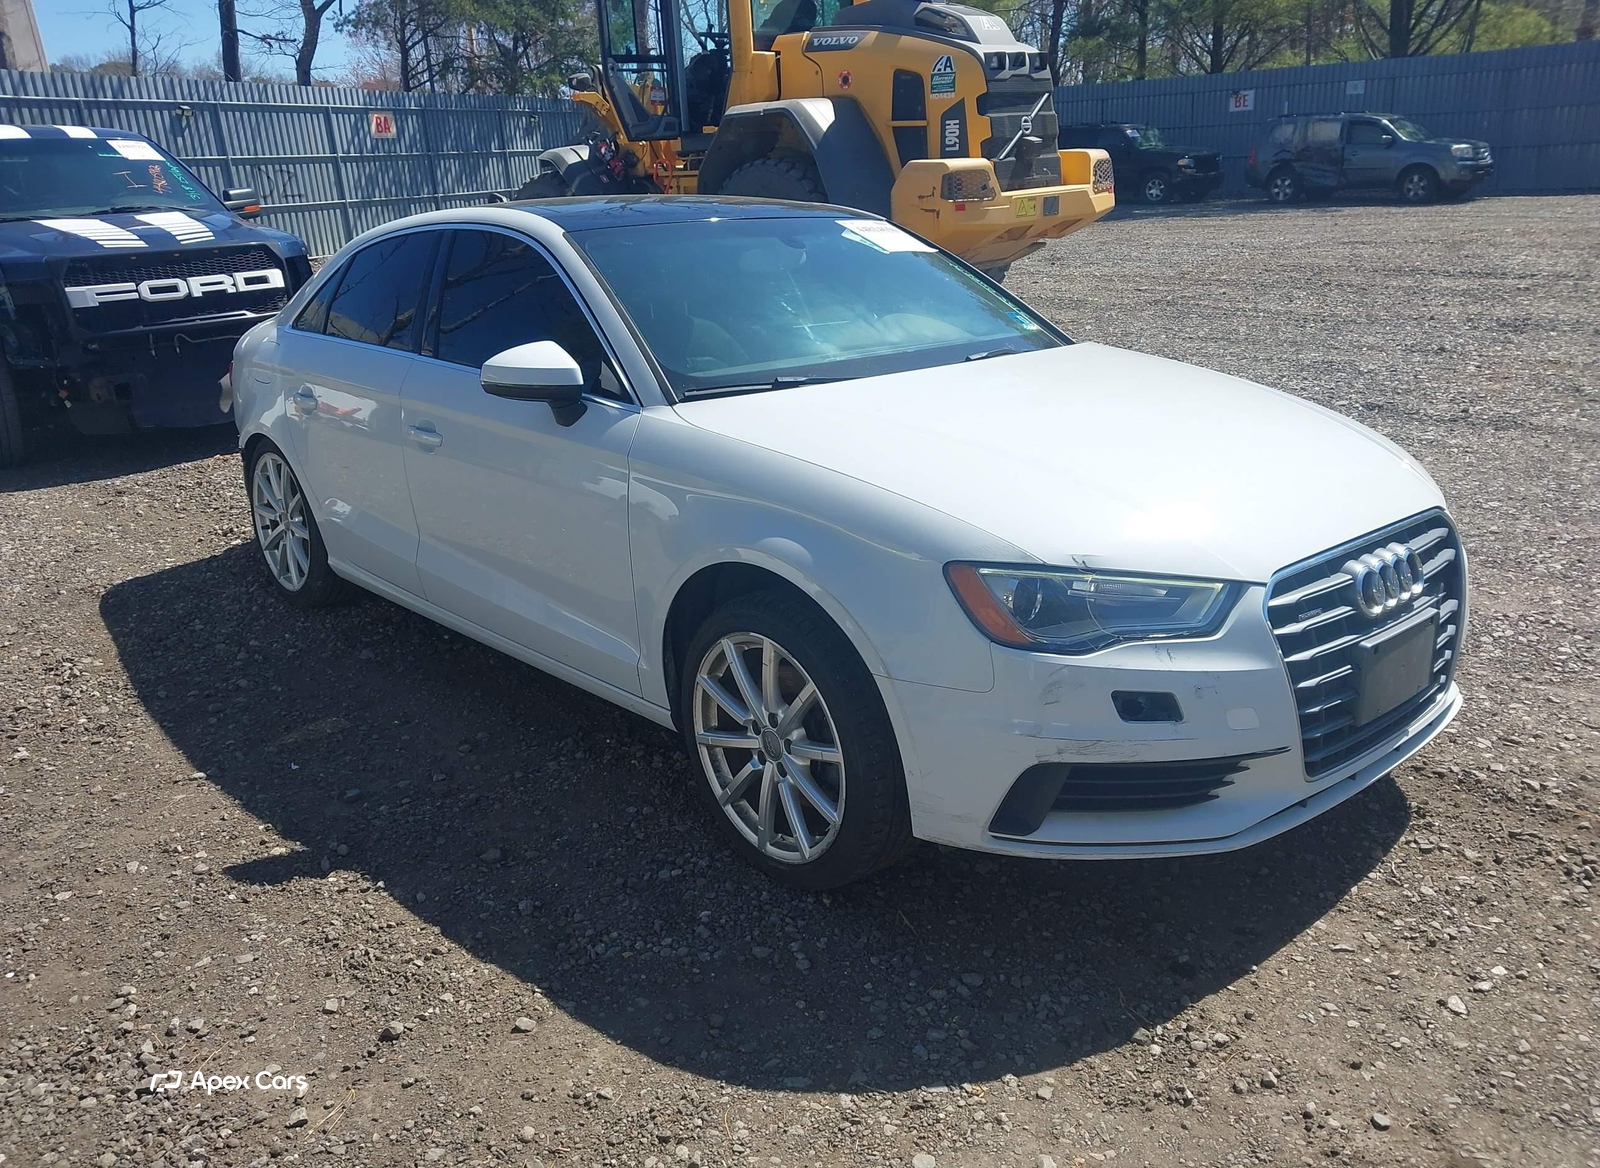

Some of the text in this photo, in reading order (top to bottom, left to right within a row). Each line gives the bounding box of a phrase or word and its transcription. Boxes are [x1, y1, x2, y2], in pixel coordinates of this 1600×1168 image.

[812, 36, 859, 46] VOLVO
[931, 54, 954, 72] AA
[1234, 94, 1249, 108] BE
[375, 116, 391, 133] BA
[945, 119, 960, 151] L90H
[65, 268, 285, 308] FORD
